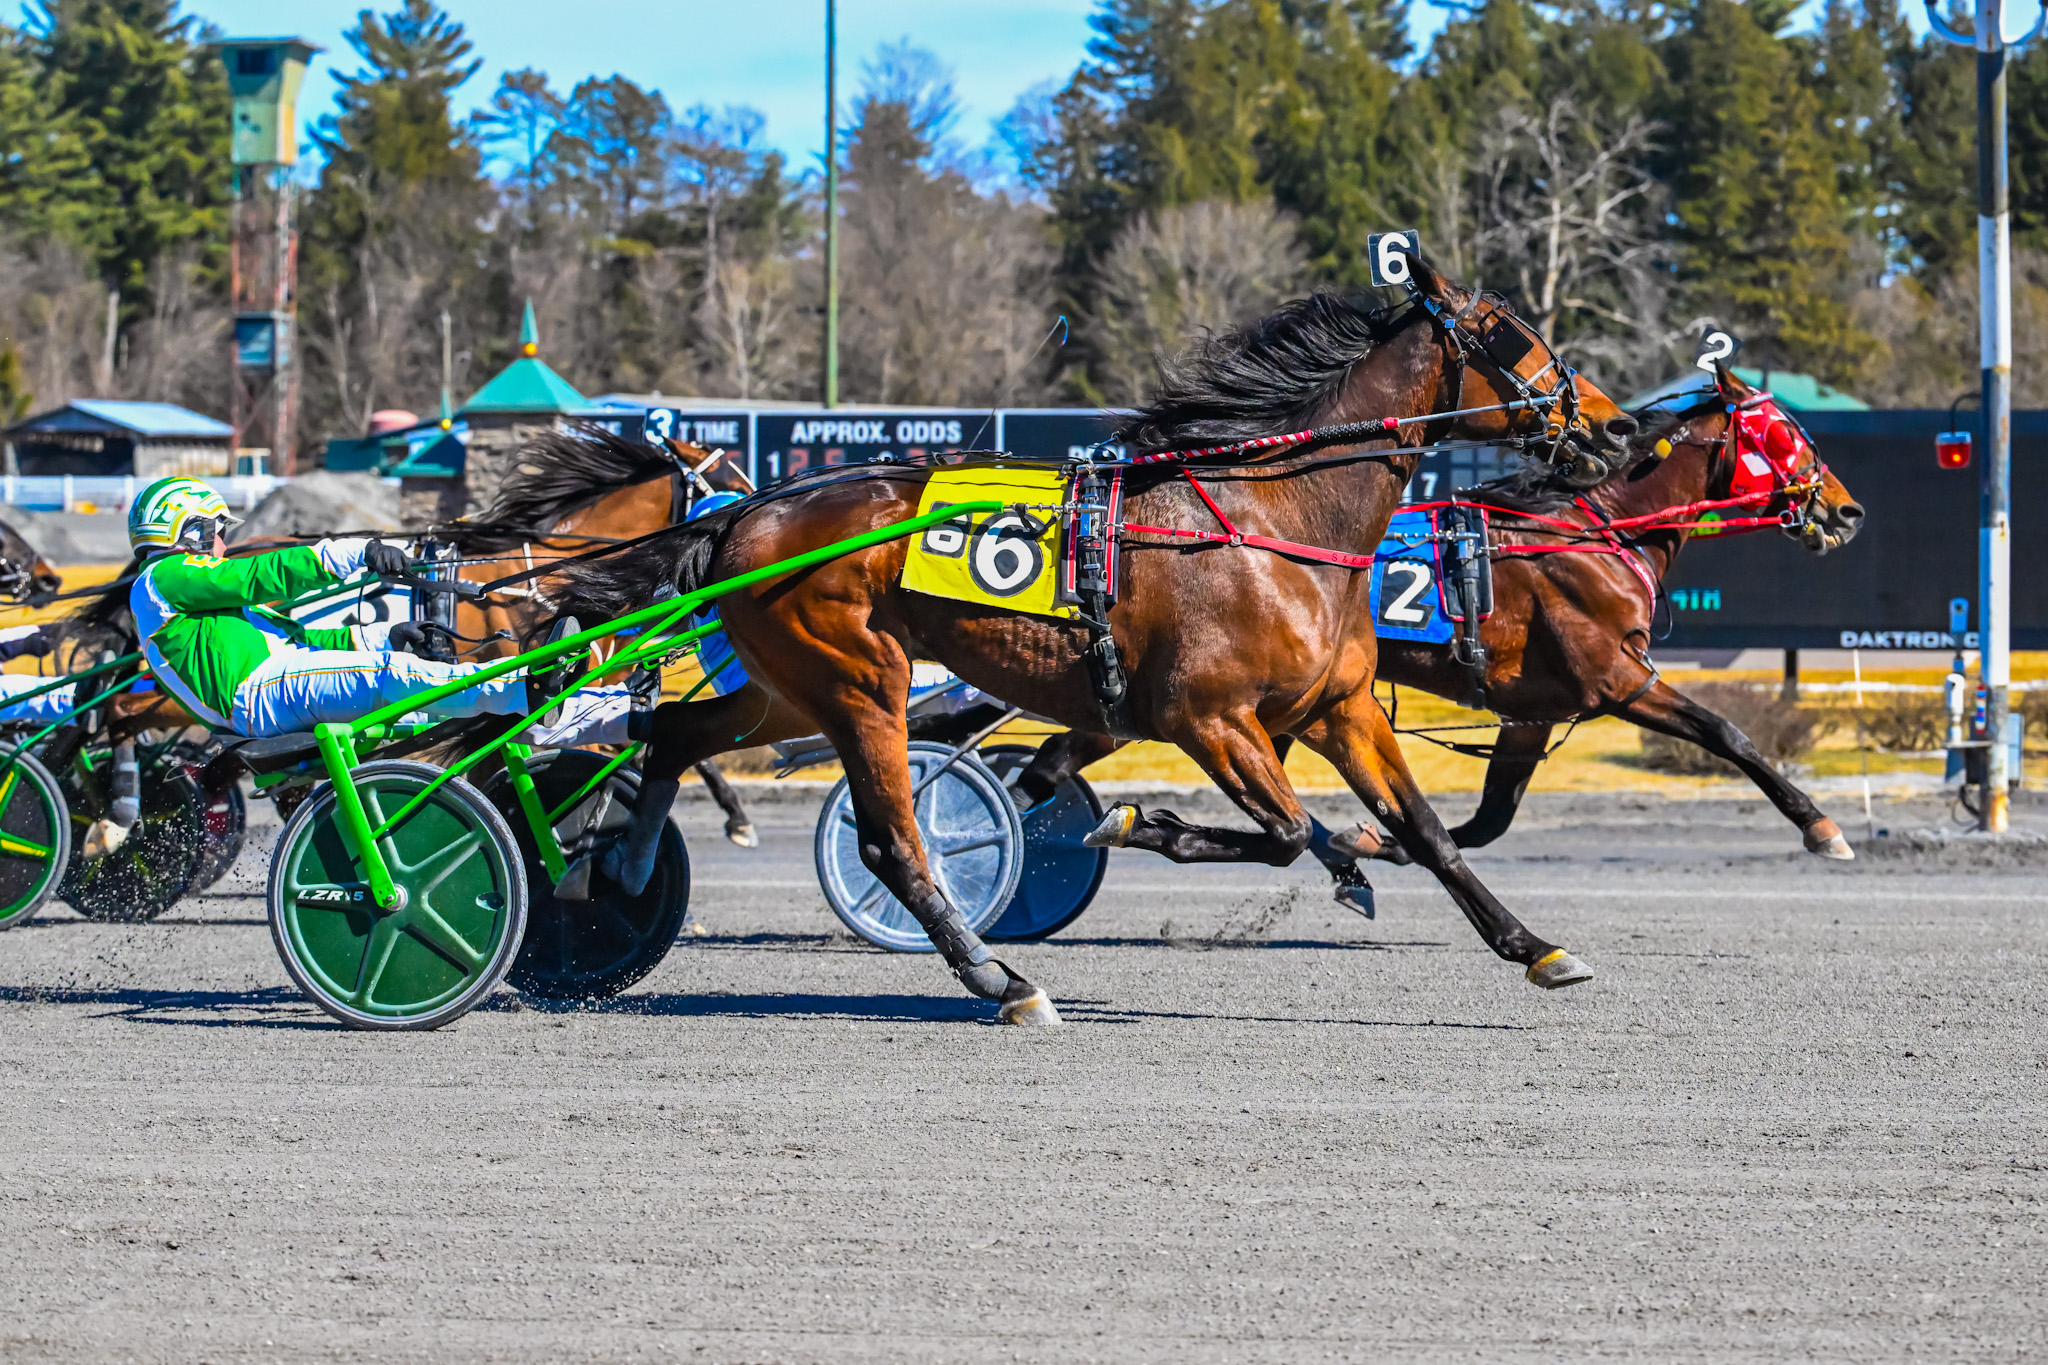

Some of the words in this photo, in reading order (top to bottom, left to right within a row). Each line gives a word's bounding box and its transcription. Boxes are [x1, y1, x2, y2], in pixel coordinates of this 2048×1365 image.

[1378, 232, 1411, 284] 6
[1696, 332, 1733, 373] 2
[645, 409, 672, 445] 3
[693, 421, 740, 444] TIME
[790, 420, 891, 444] APPROX.
[896, 420, 962, 444] ODDS
[765, 451, 781, 478] 1
[1421, 472, 1439, 499] 7
[976, 516, 1037, 590] 6
[1384, 561, 1431, 622] 2
[1840, 631, 1980, 648] DAKTRONC
